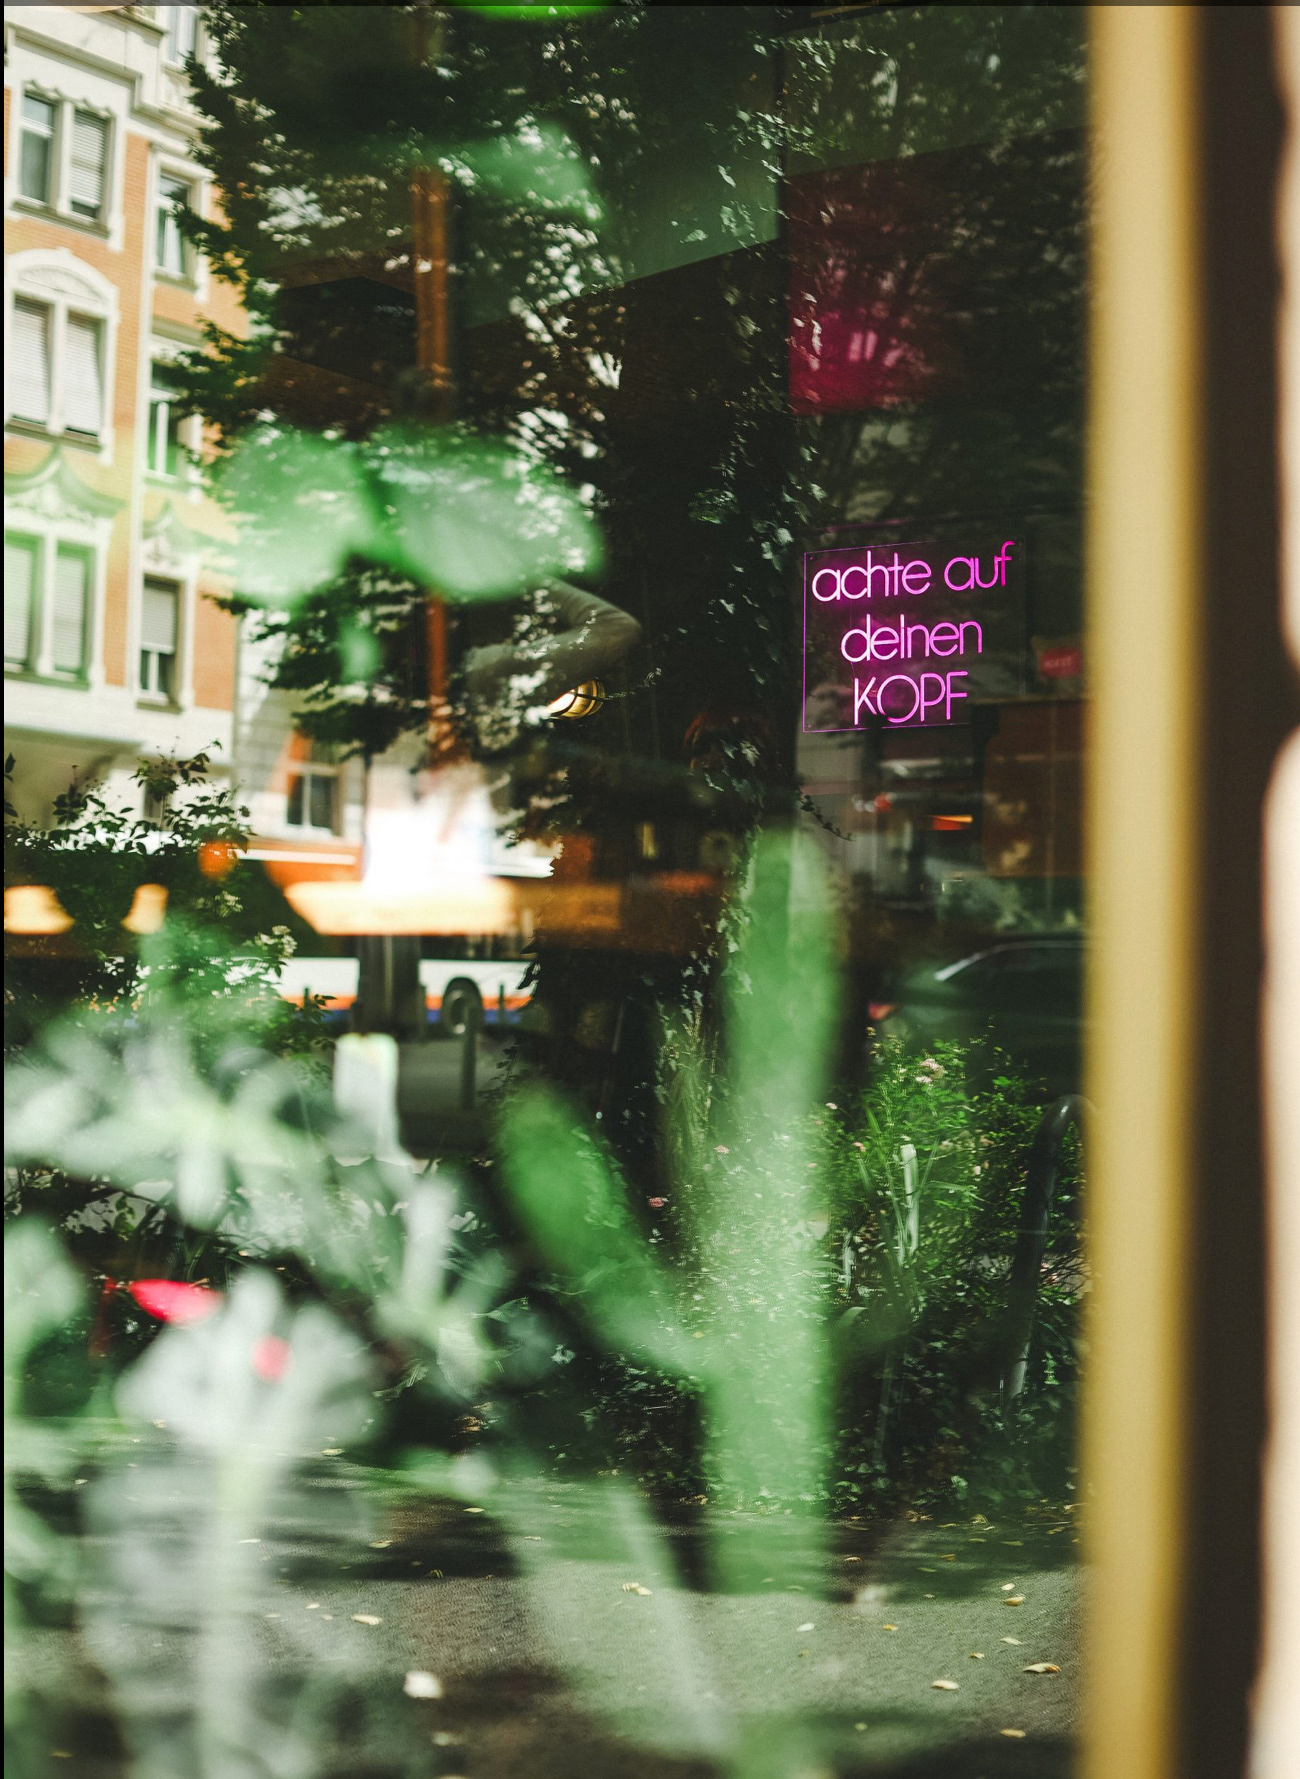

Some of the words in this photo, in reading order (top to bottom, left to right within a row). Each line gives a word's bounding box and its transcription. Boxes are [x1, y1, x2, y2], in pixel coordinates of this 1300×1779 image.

[812, 551, 932, 602] achte
[944, 541, 1015, 591] auf
[854, 671, 968, 726] KOPF
